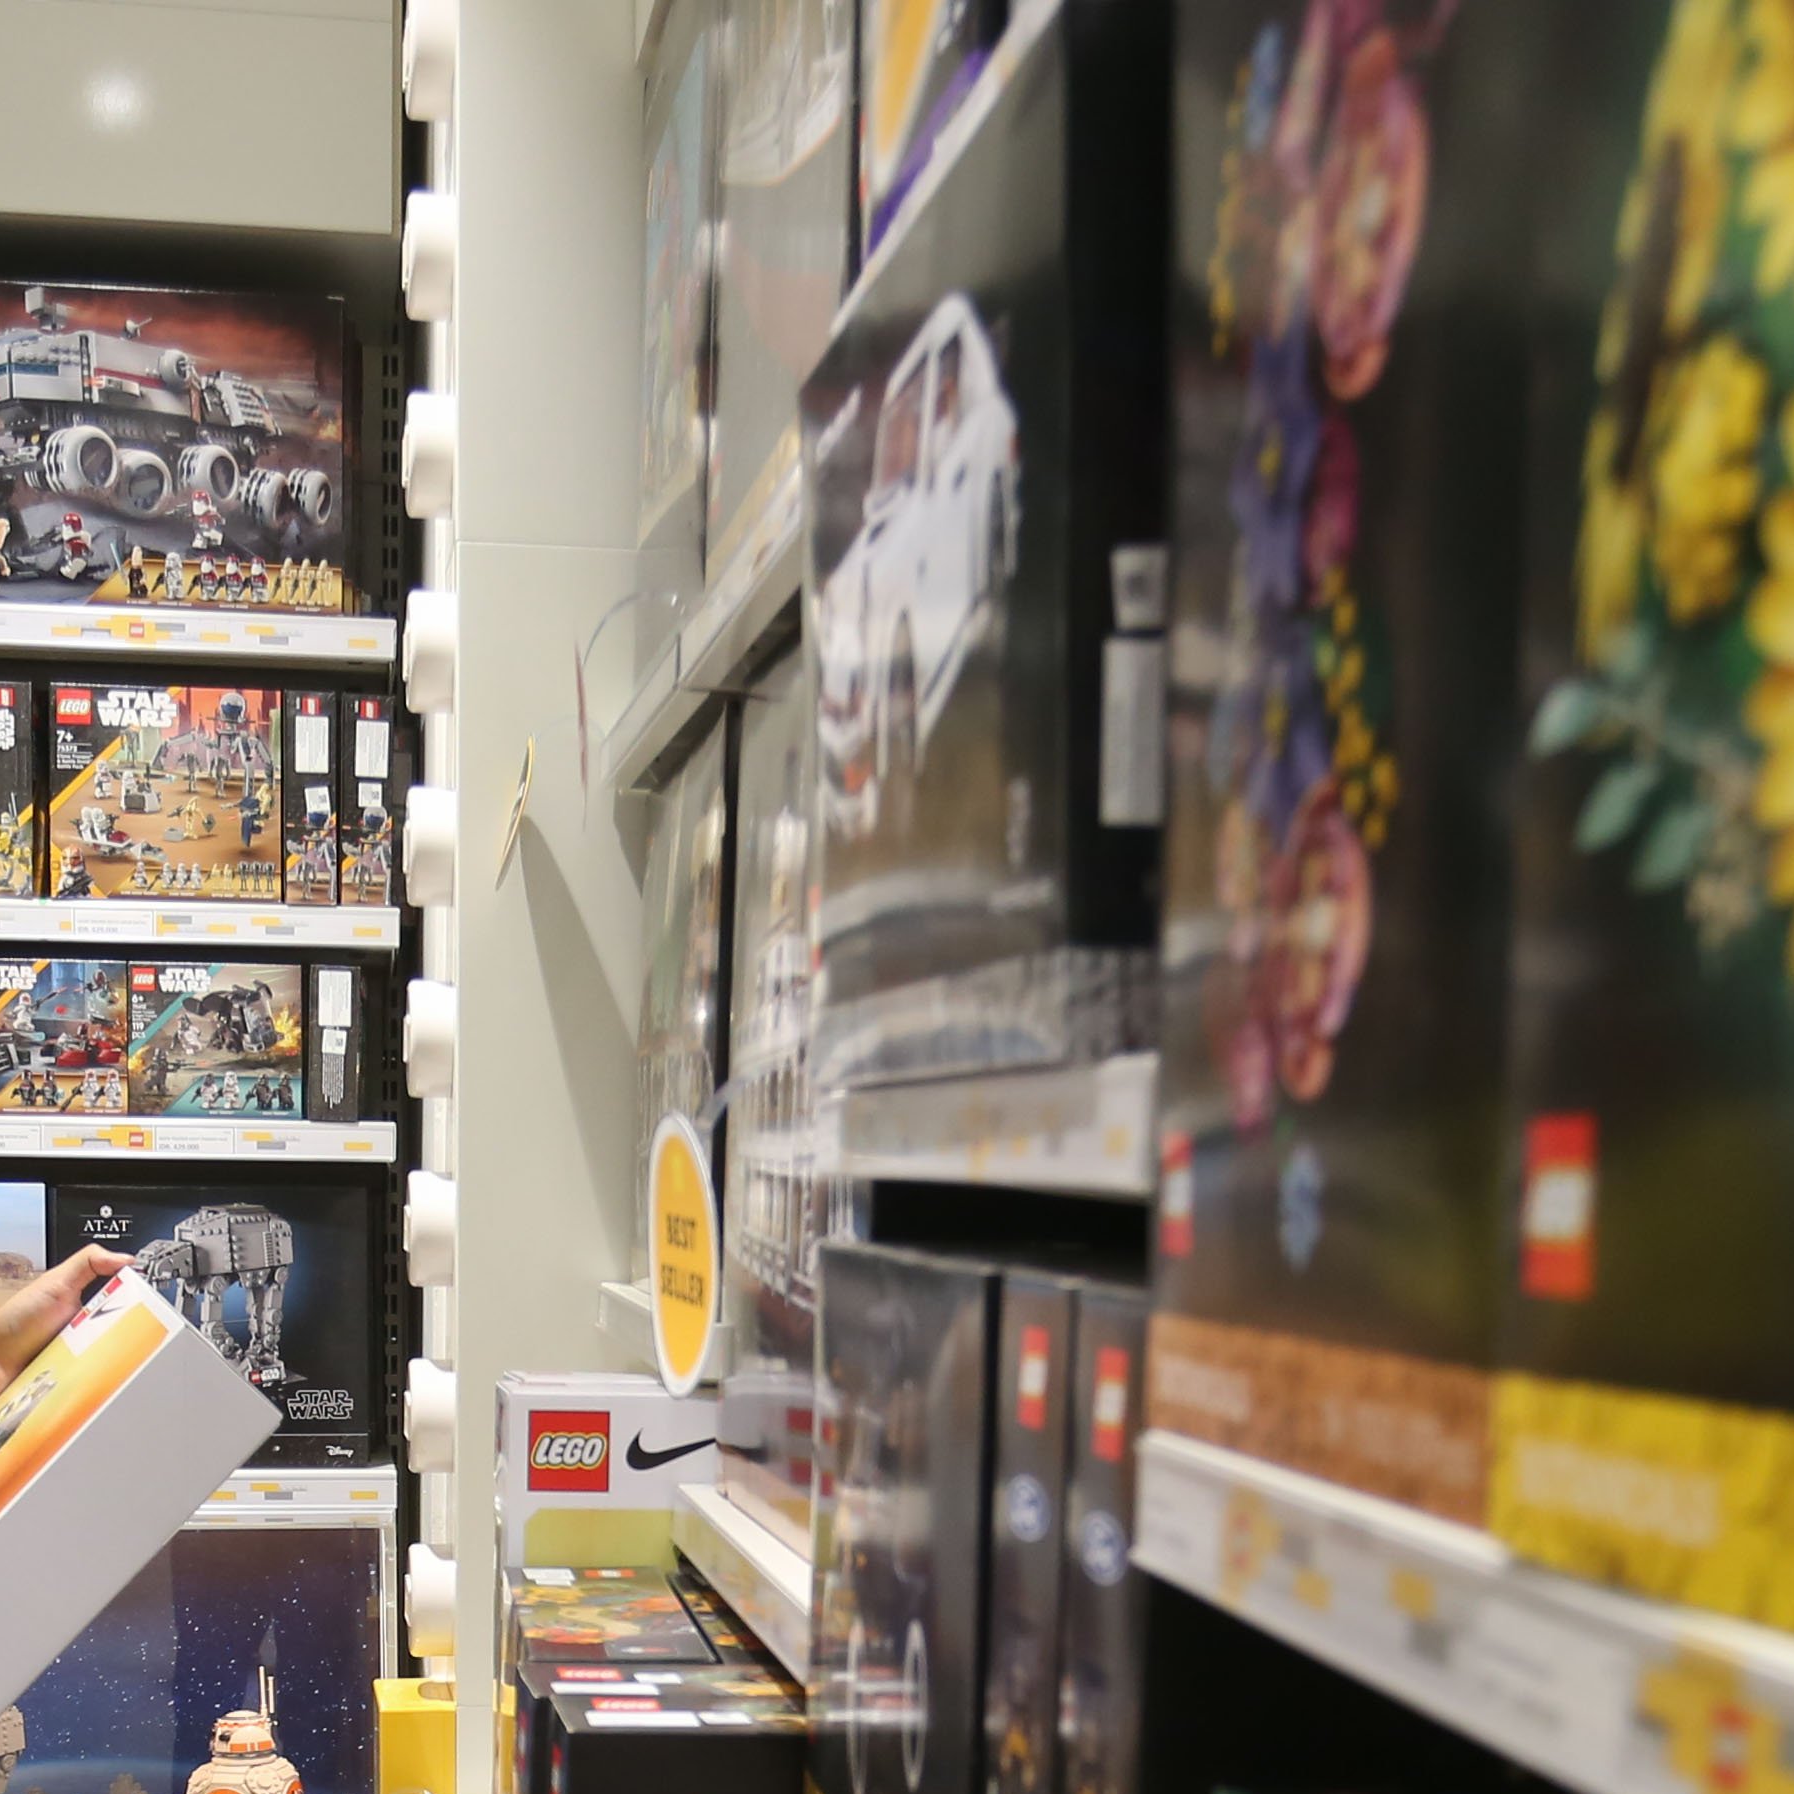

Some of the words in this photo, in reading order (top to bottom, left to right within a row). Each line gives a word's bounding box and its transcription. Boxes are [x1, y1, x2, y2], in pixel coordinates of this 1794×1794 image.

[59, 699, 91, 715] LEGO
[97, 691, 177, 711] STAR
[98, 708, 178, 728] WARS
[56, 729, 74, 743] 7+
[133, 974, 155, 985] LEGO
[158, 967, 211, 982] STAR
[159, 979, 210, 993] WARS
[132, 994, 144, 1003] 6+
[132, 1023, 145, 1031] 119
[84, 1219, 130, 1232] AT-AT
[666, 1213, 696, 1250] BEST
[660, 1264, 703, 1307] SELLER
[287, 1390, 353, 1406] STAR
[287, 1403, 353, 1420] WARS
[531, 1433, 607, 1469] LEGO
